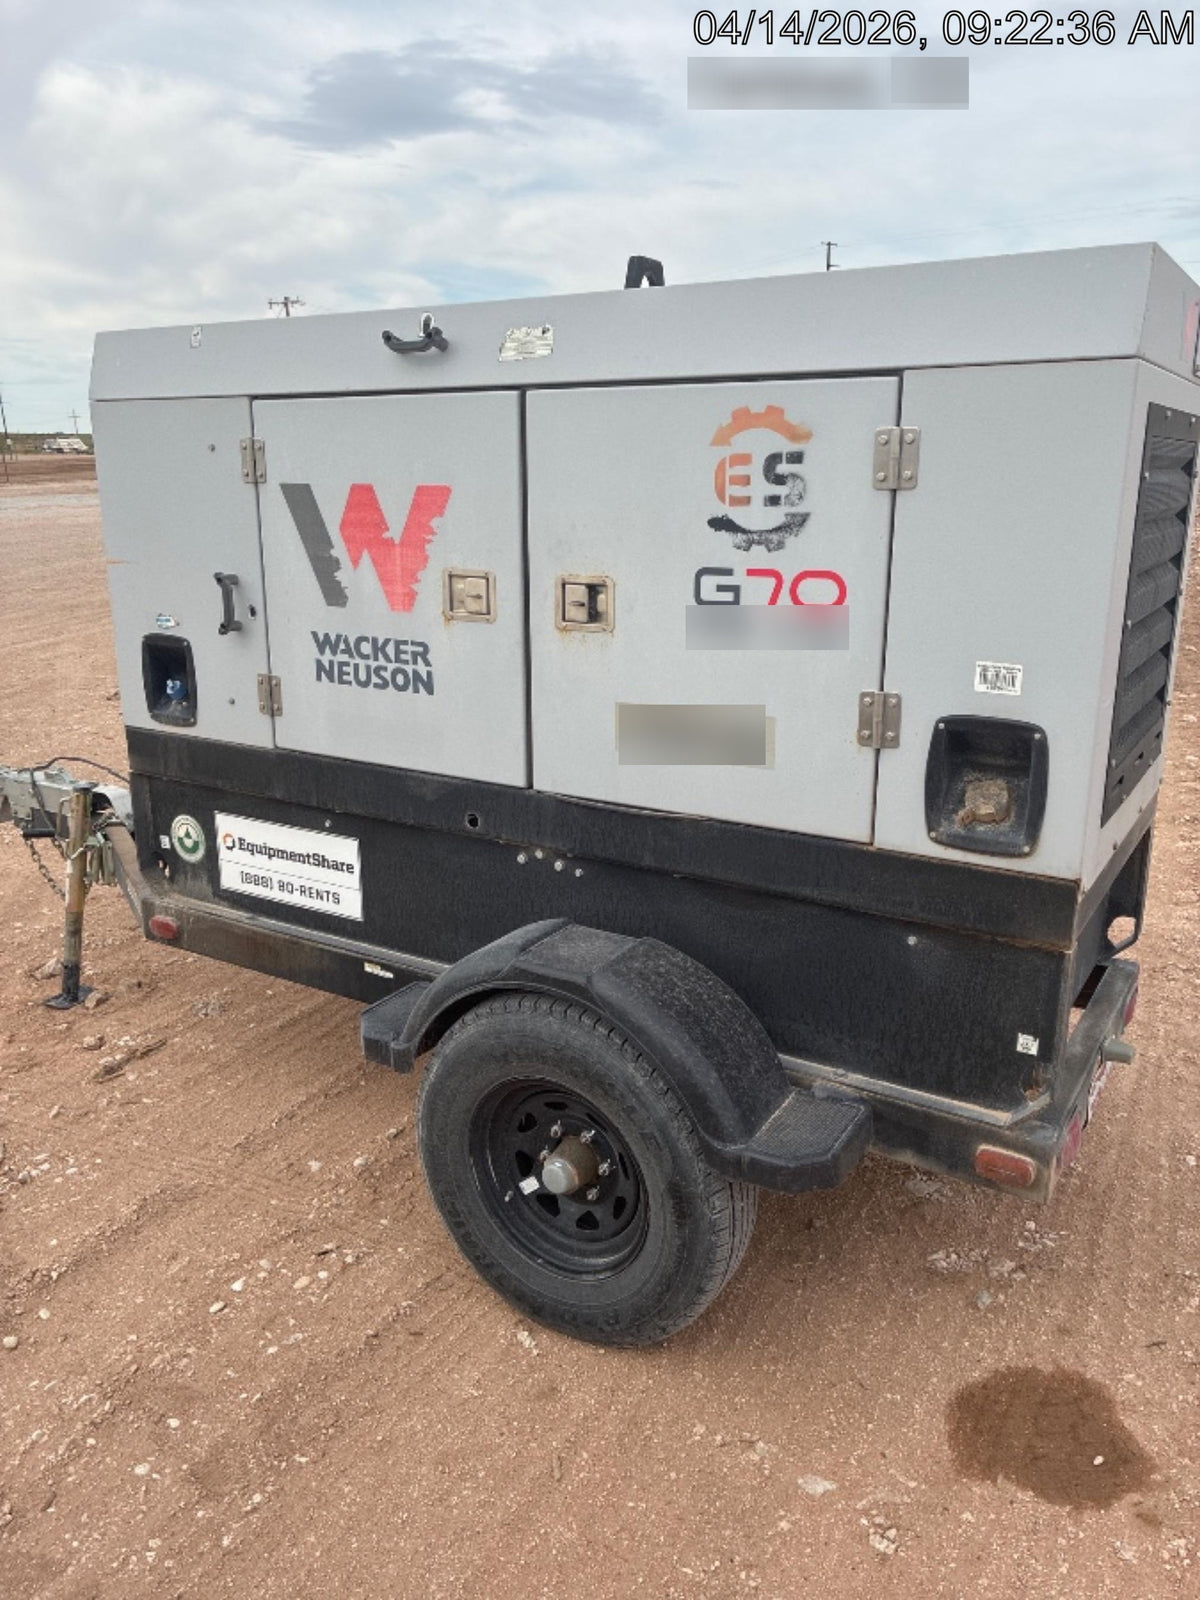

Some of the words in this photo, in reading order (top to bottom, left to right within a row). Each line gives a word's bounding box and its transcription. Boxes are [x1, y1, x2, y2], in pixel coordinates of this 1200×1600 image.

[714, 451, 807, 507] ES
[693, 567, 847, 605] G70
[310, 631, 432, 667] WACKER
[315, 659, 434, 695] NEUSON
[238, 837, 354, 873] EquipmentShare
[241, 871, 274, 890] (888)
[278, 879, 340, 905] 80-RENTS
